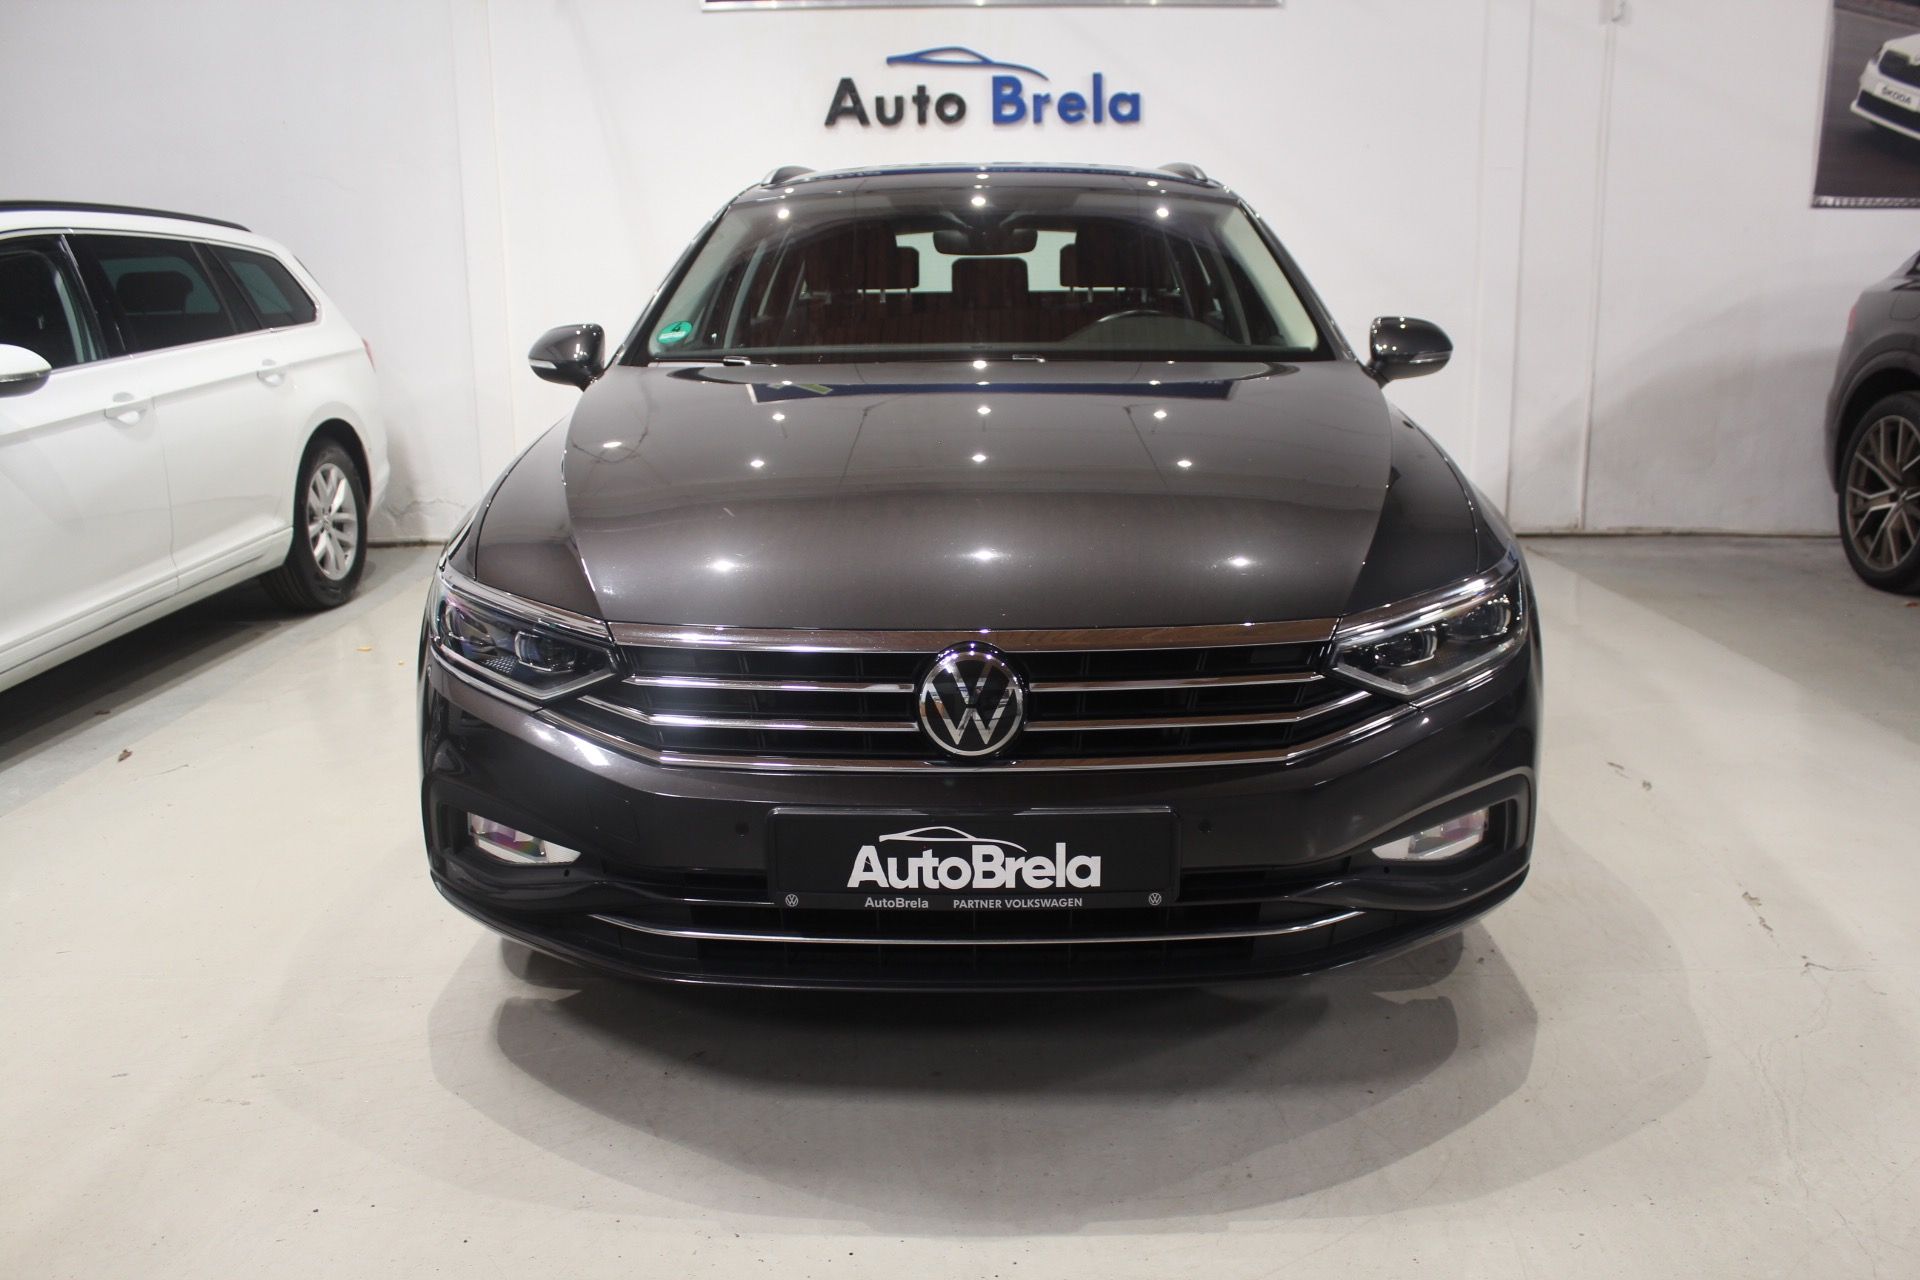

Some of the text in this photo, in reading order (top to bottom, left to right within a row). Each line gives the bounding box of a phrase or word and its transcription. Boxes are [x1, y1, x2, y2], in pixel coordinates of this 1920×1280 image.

[825, 73, 1141, 127] Auto Brela
[847, 842, 1102, 890] AutoBrela
[864, 897, 1083, 909] AutoBrela PARTNER VOLKSWAGEN
